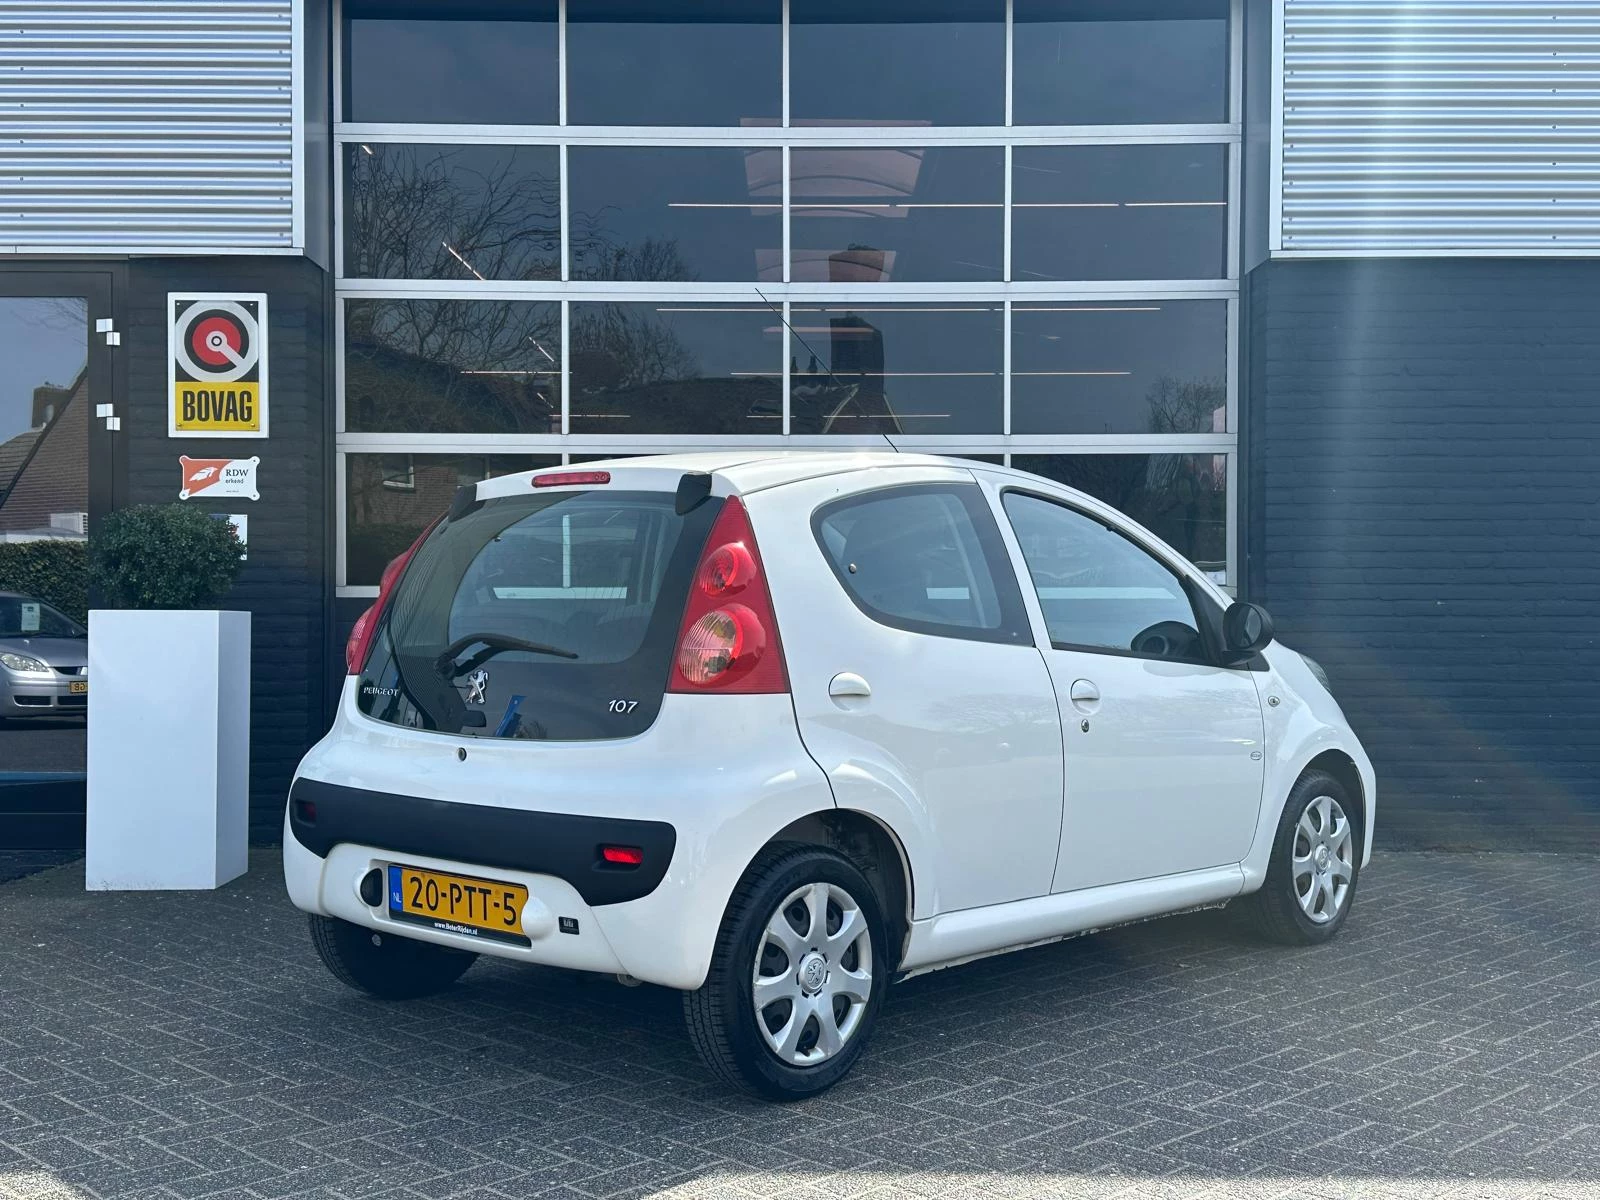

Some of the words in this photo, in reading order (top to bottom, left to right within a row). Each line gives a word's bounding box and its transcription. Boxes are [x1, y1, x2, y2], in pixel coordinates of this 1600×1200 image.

[182, 390, 252, 422] BOVAG
[225, 469, 249, 477] RDW
[363, 687, 399, 697] PEUGEOT
[609, 699, 638, 714] 107
[392, 892, 402, 904] NL
[410, 876, 517, 926] 20-PTT-5
